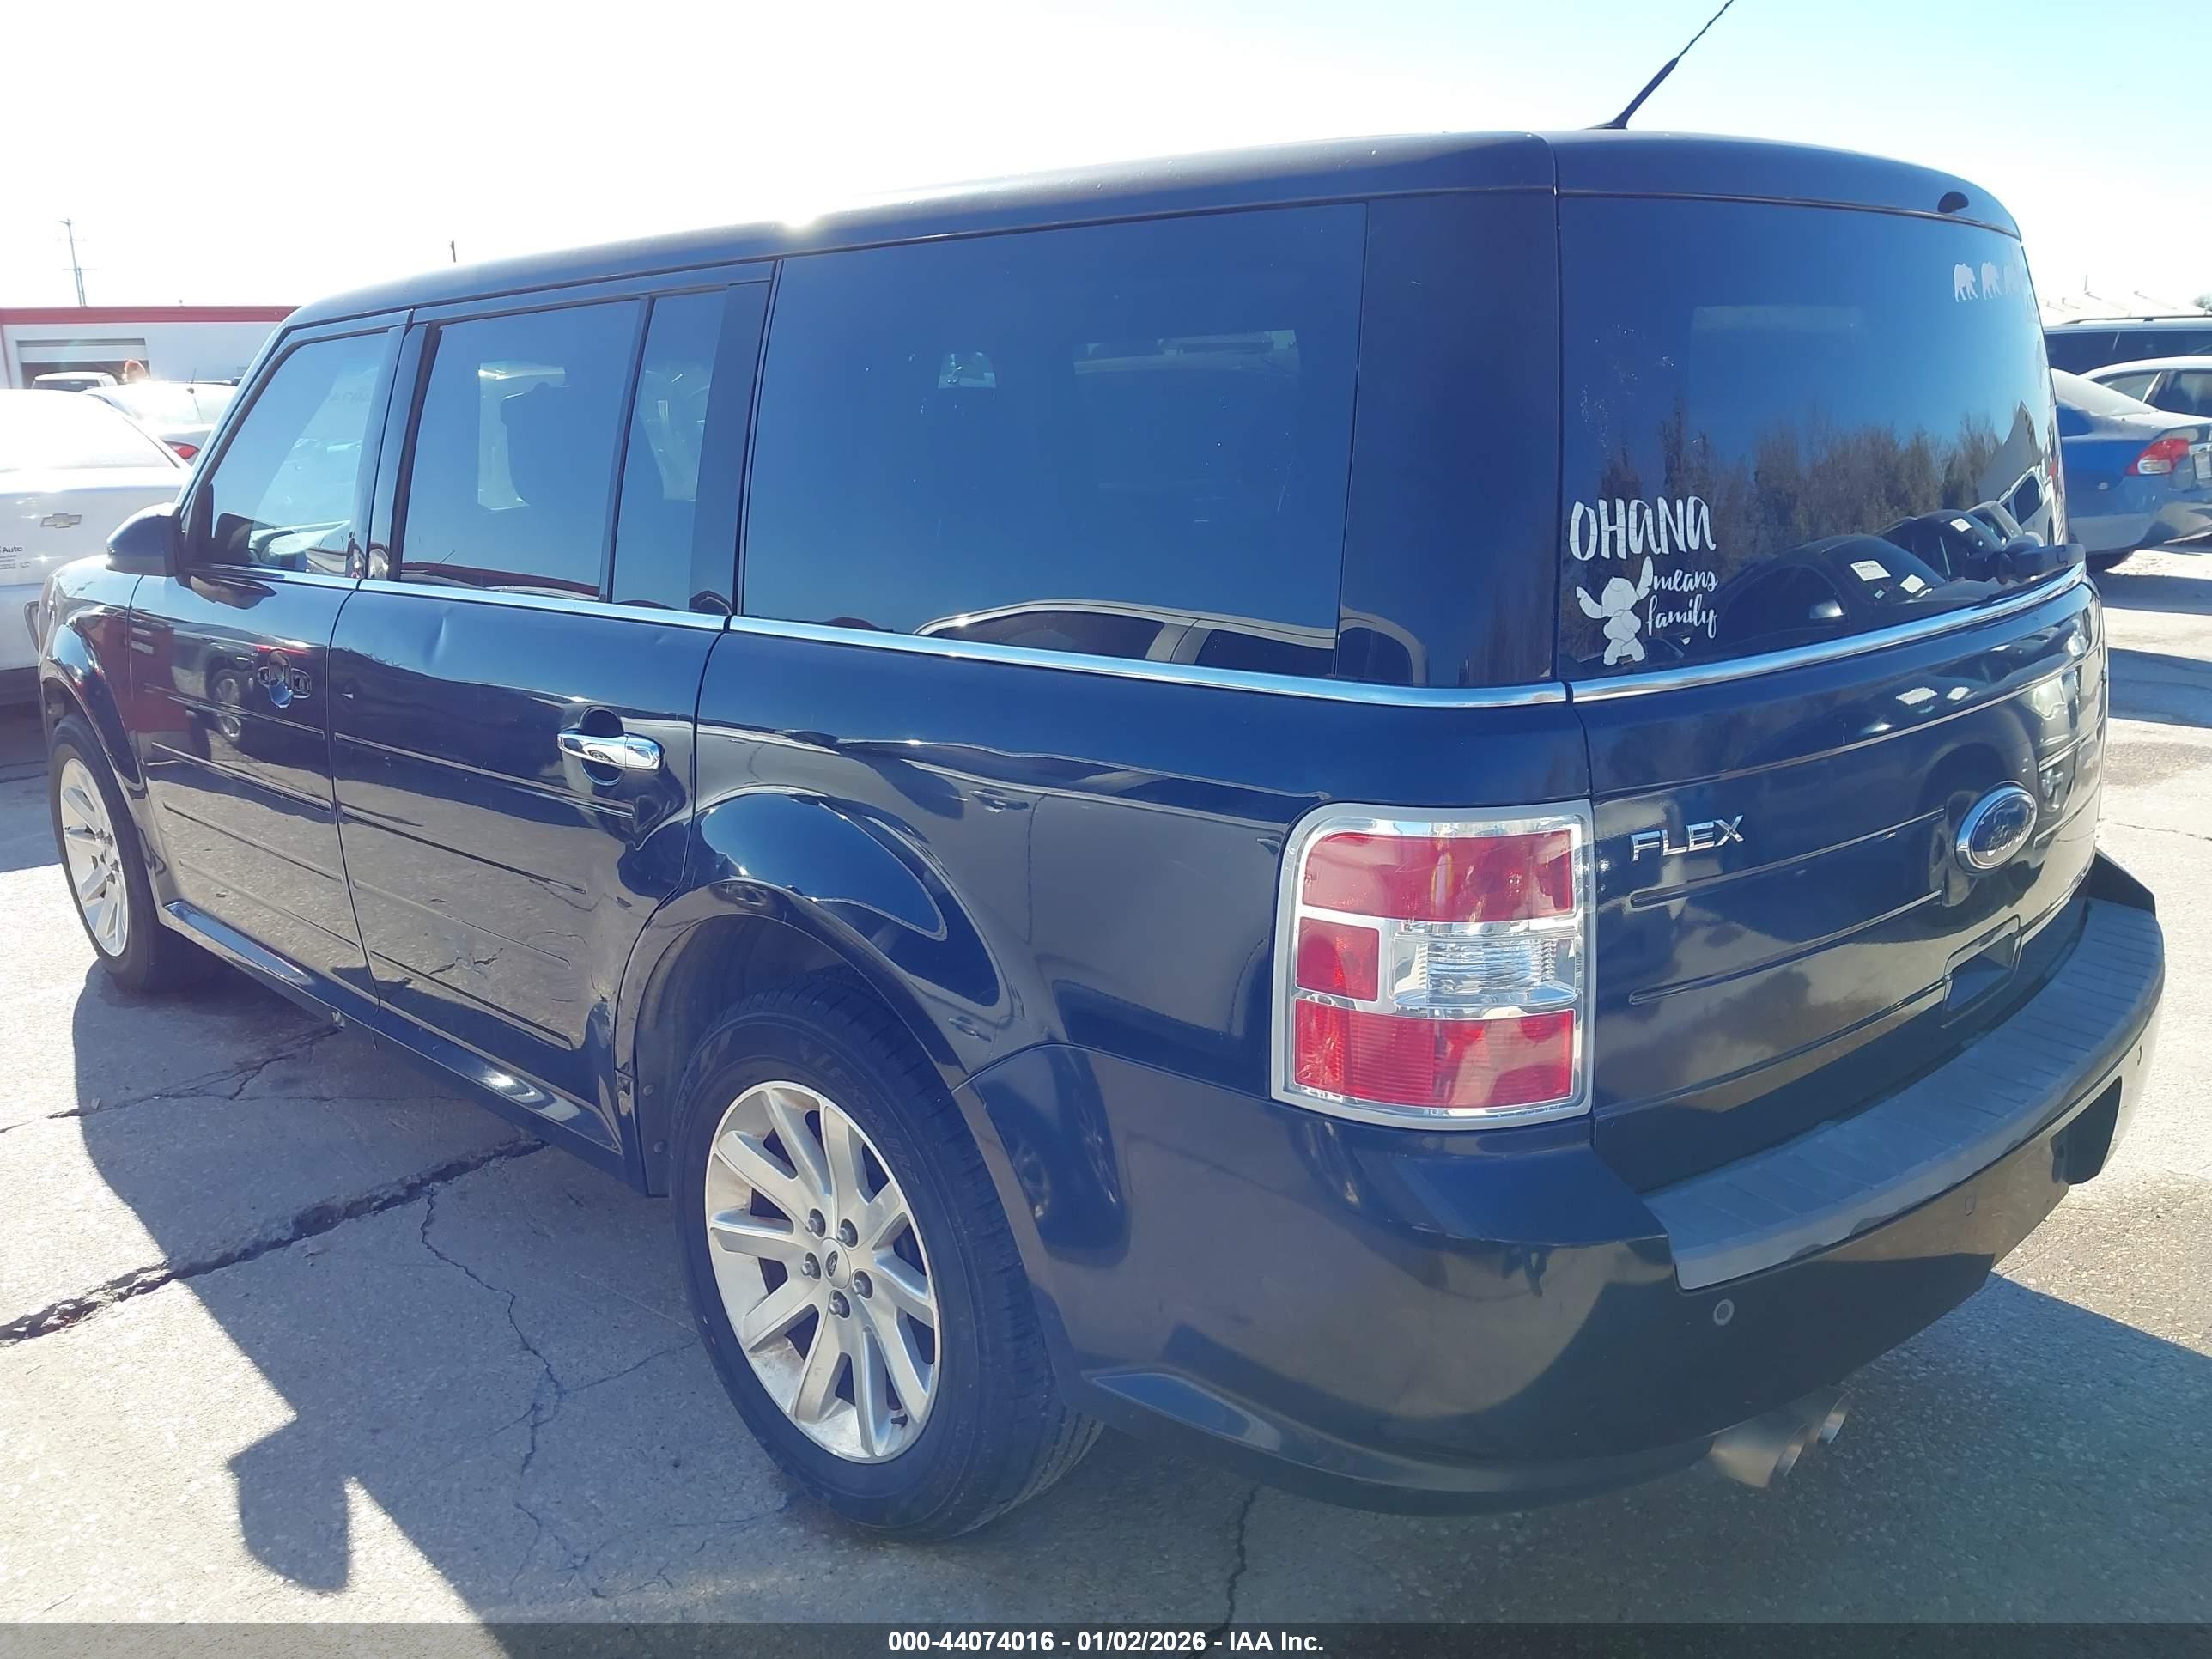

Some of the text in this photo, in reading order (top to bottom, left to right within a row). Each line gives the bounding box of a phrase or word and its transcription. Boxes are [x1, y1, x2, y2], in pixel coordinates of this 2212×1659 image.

[1653, 569, 1718, 592] means
[1646, 594, 1717, 638] family
[1631, 815, 1744, 861] FLEX
